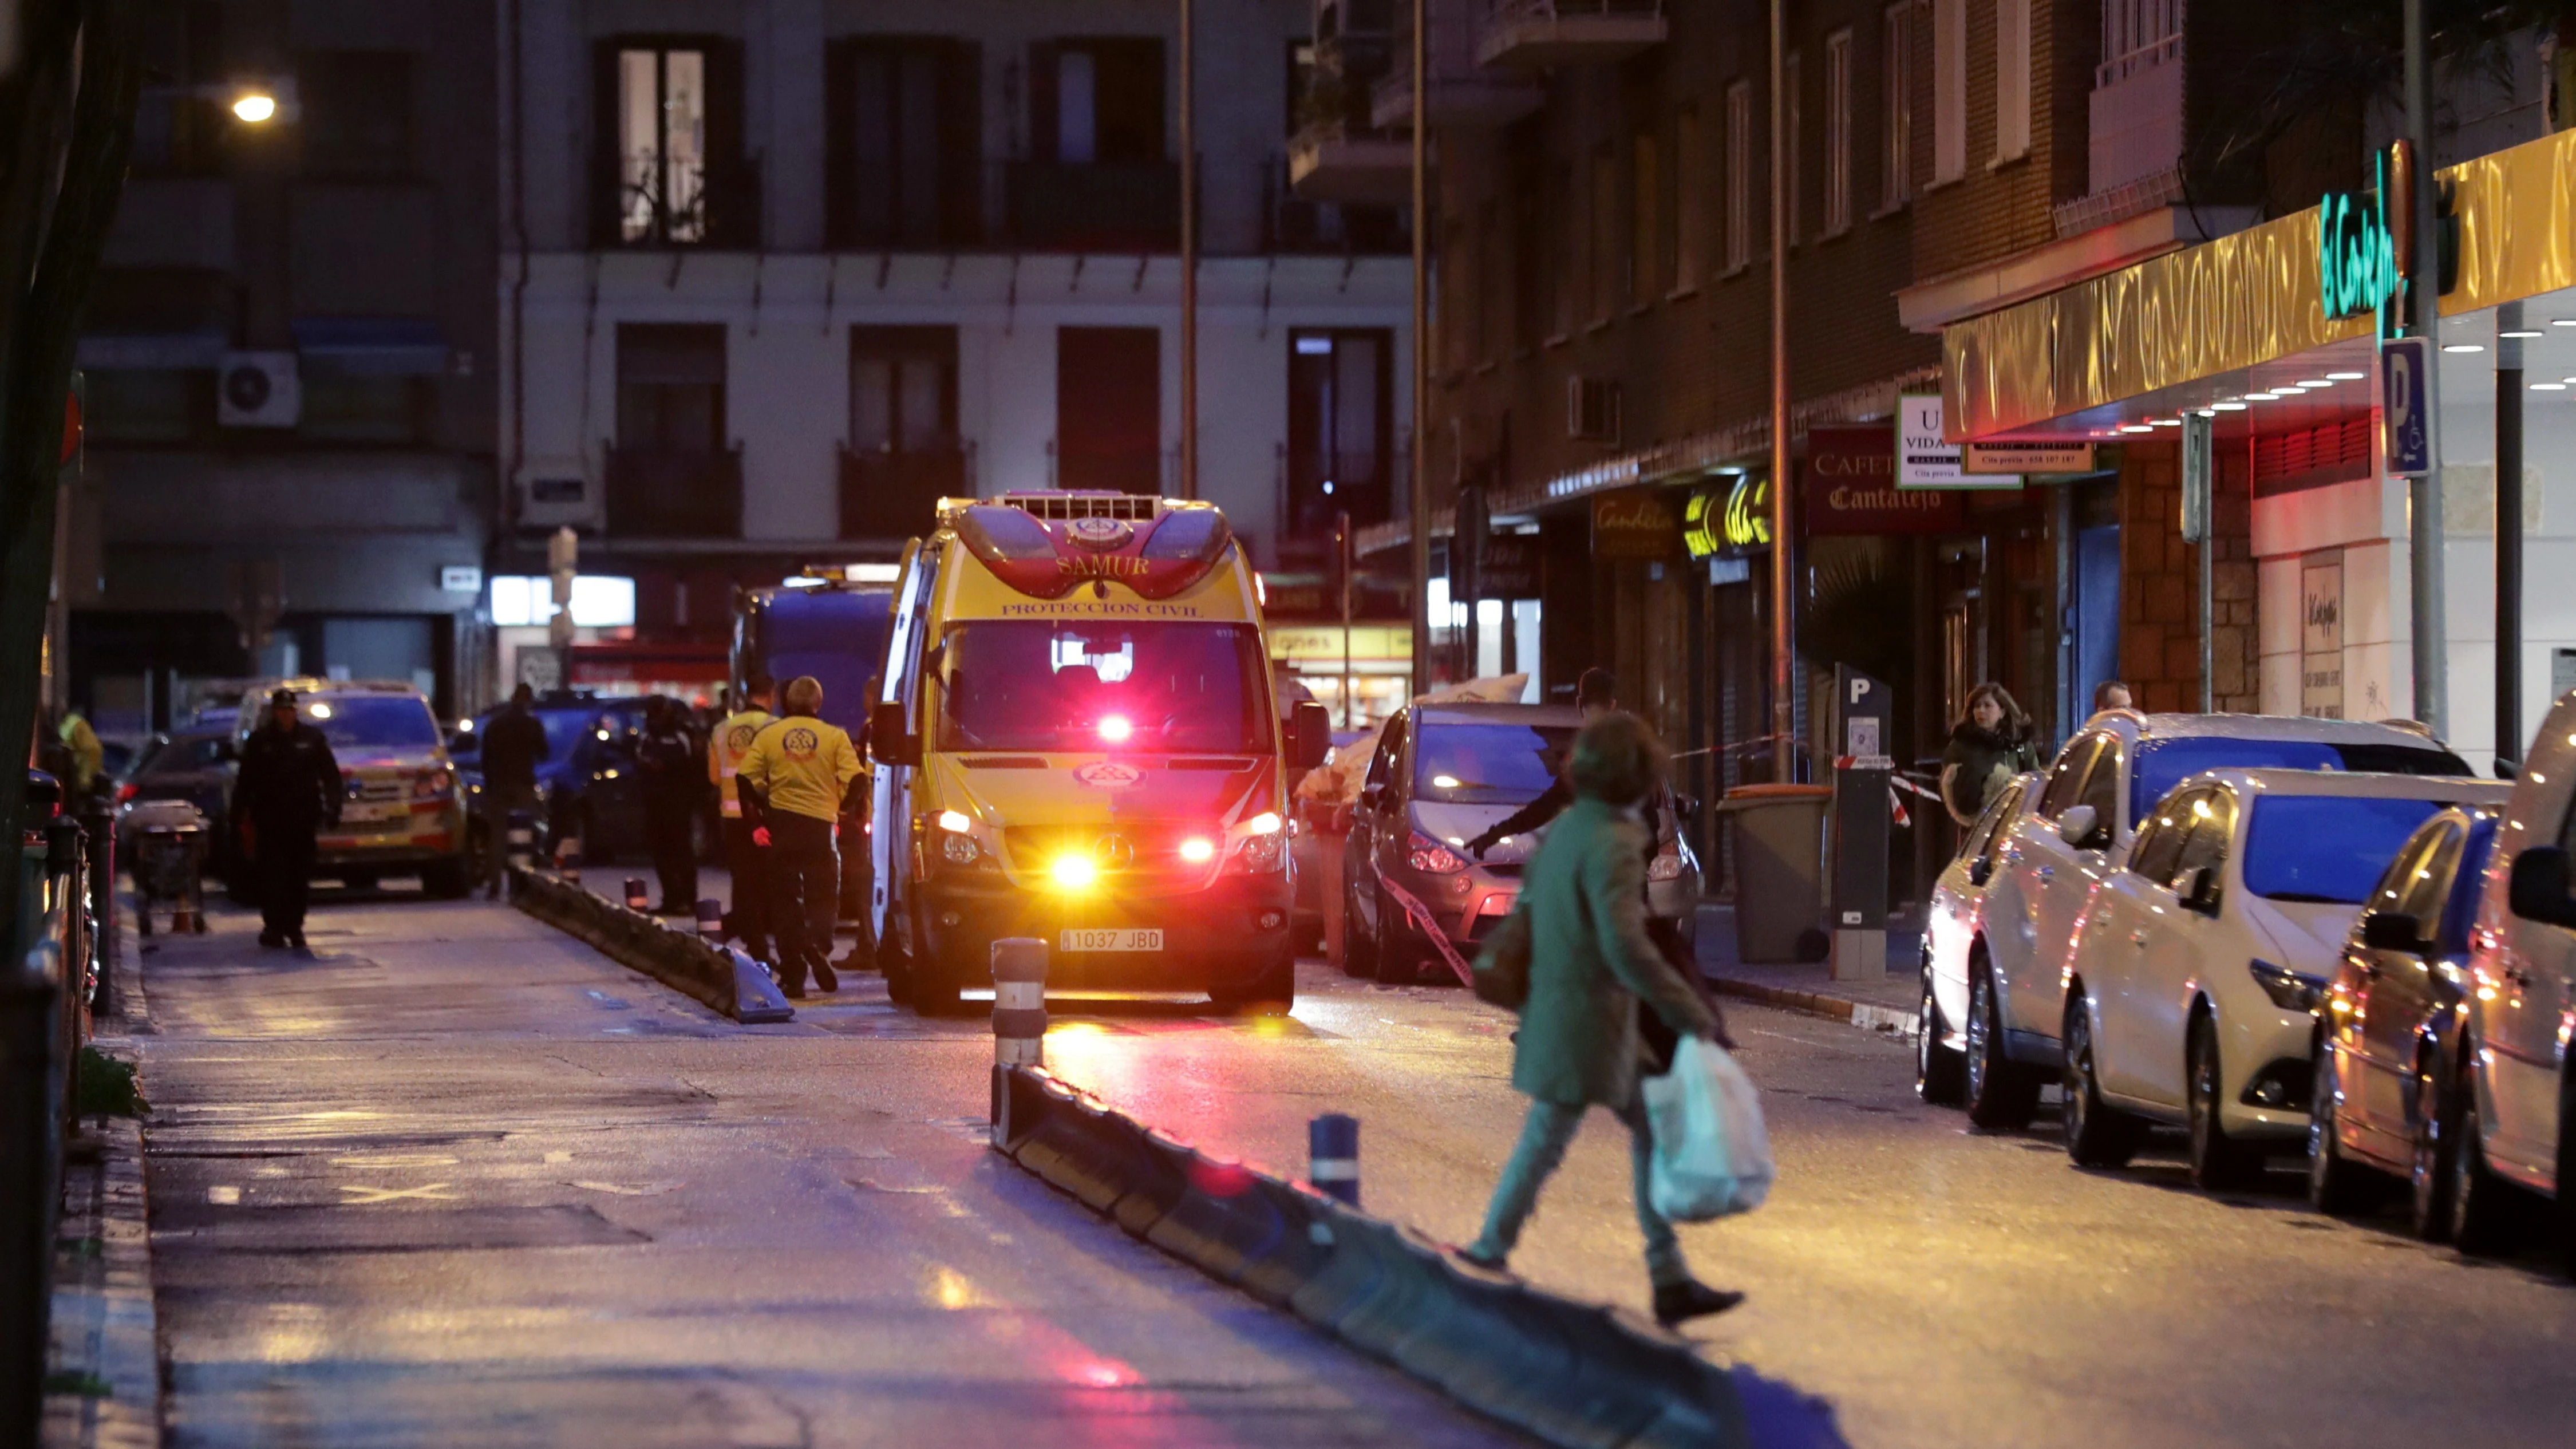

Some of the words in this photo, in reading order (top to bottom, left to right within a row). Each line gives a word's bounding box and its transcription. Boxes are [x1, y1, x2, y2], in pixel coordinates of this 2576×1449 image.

[2390, 353, 2410, 458] P
[1055, 553, 1150, 576] SAMUR
[1002, 603, 1139, 615] PROTECCION
[1146, 604, 1204, 618] CIVIL
[1851, 678, 1870, 704] P
[1076, 931, 1118, 948] 1037
[1126, 931, 1159, 948] JBD
